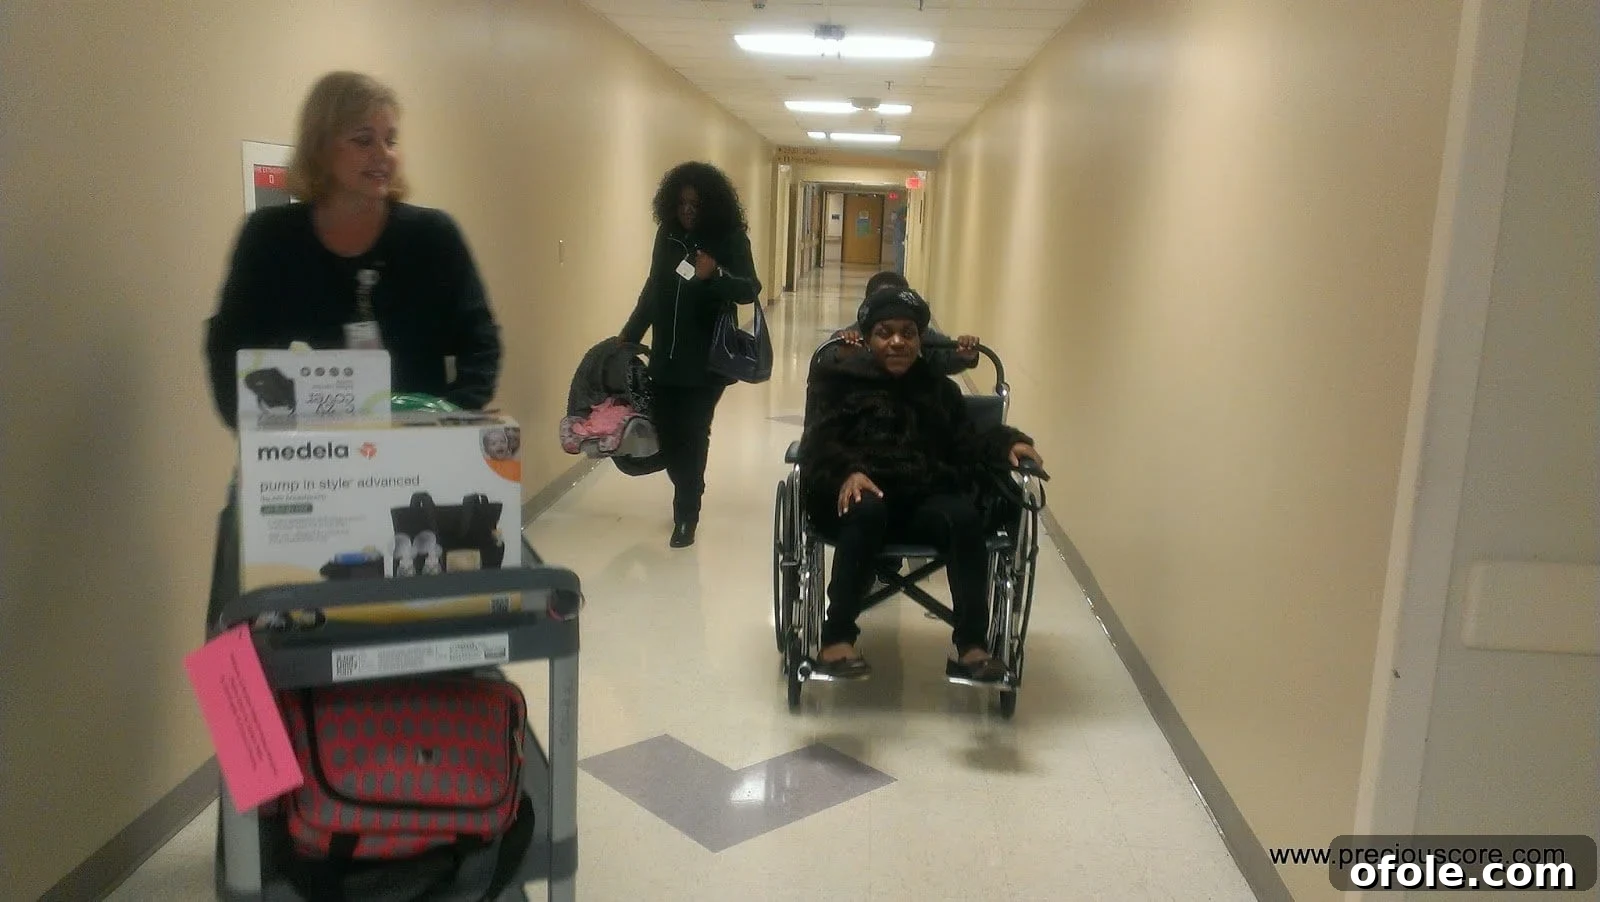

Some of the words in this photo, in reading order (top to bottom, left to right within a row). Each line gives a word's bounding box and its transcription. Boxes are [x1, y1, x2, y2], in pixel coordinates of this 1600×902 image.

[257, 441, 349, 461] medela
[260, 480, 299, 493] pump
[303, 479, 315, 490] in
[357, 474, 420, 488] advanced
